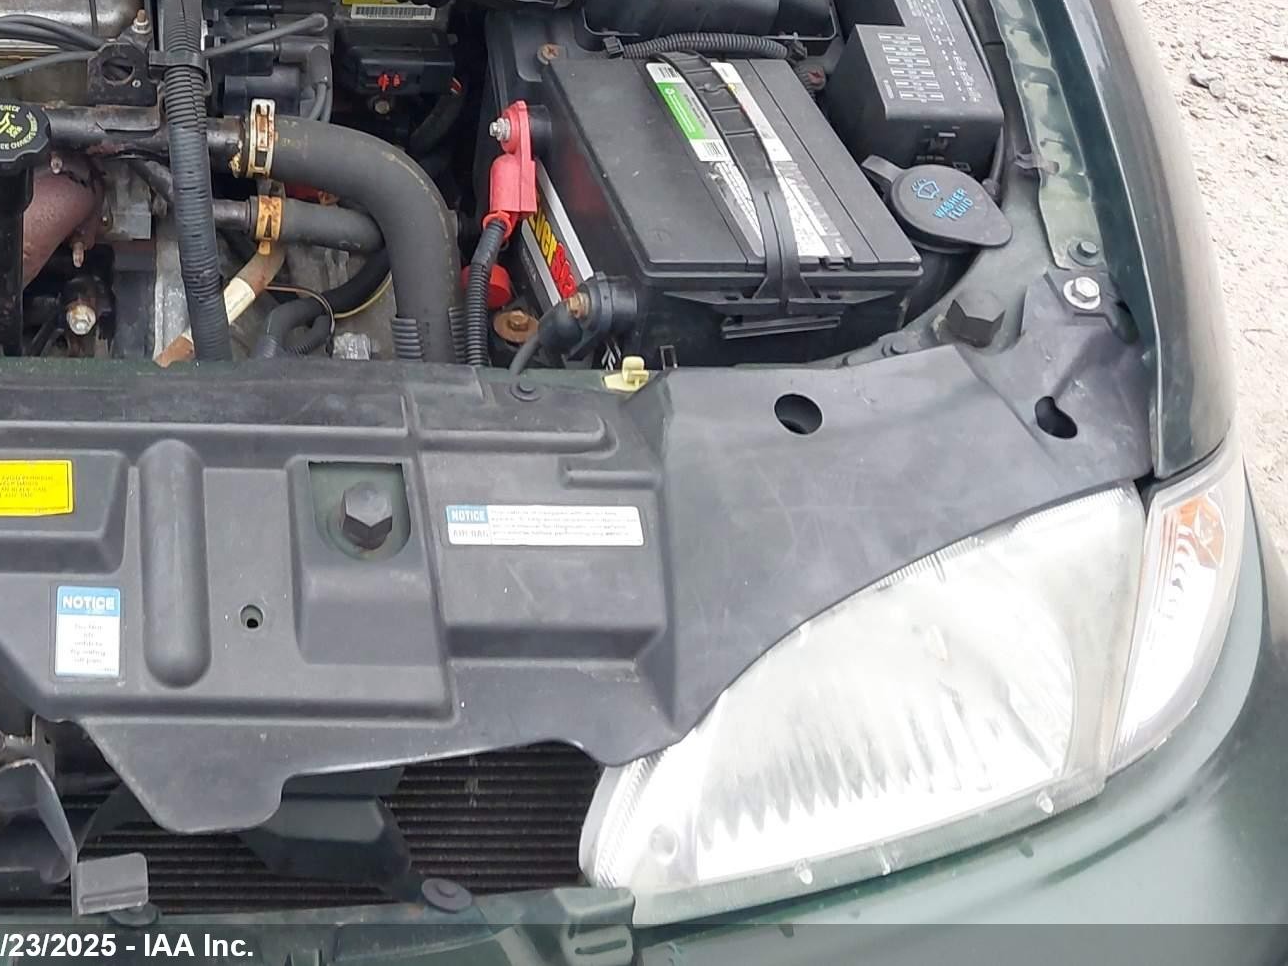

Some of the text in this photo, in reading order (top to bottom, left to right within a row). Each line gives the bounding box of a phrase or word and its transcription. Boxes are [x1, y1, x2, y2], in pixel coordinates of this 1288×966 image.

[0, 104, 21, 112] CHECK
[934, 187, 966, 218] WASHER
[948, 197, 974, 221] FLUID
[450, 509, 486, 523] NOTICE
[62, 595, 116, 611] NOTICE
